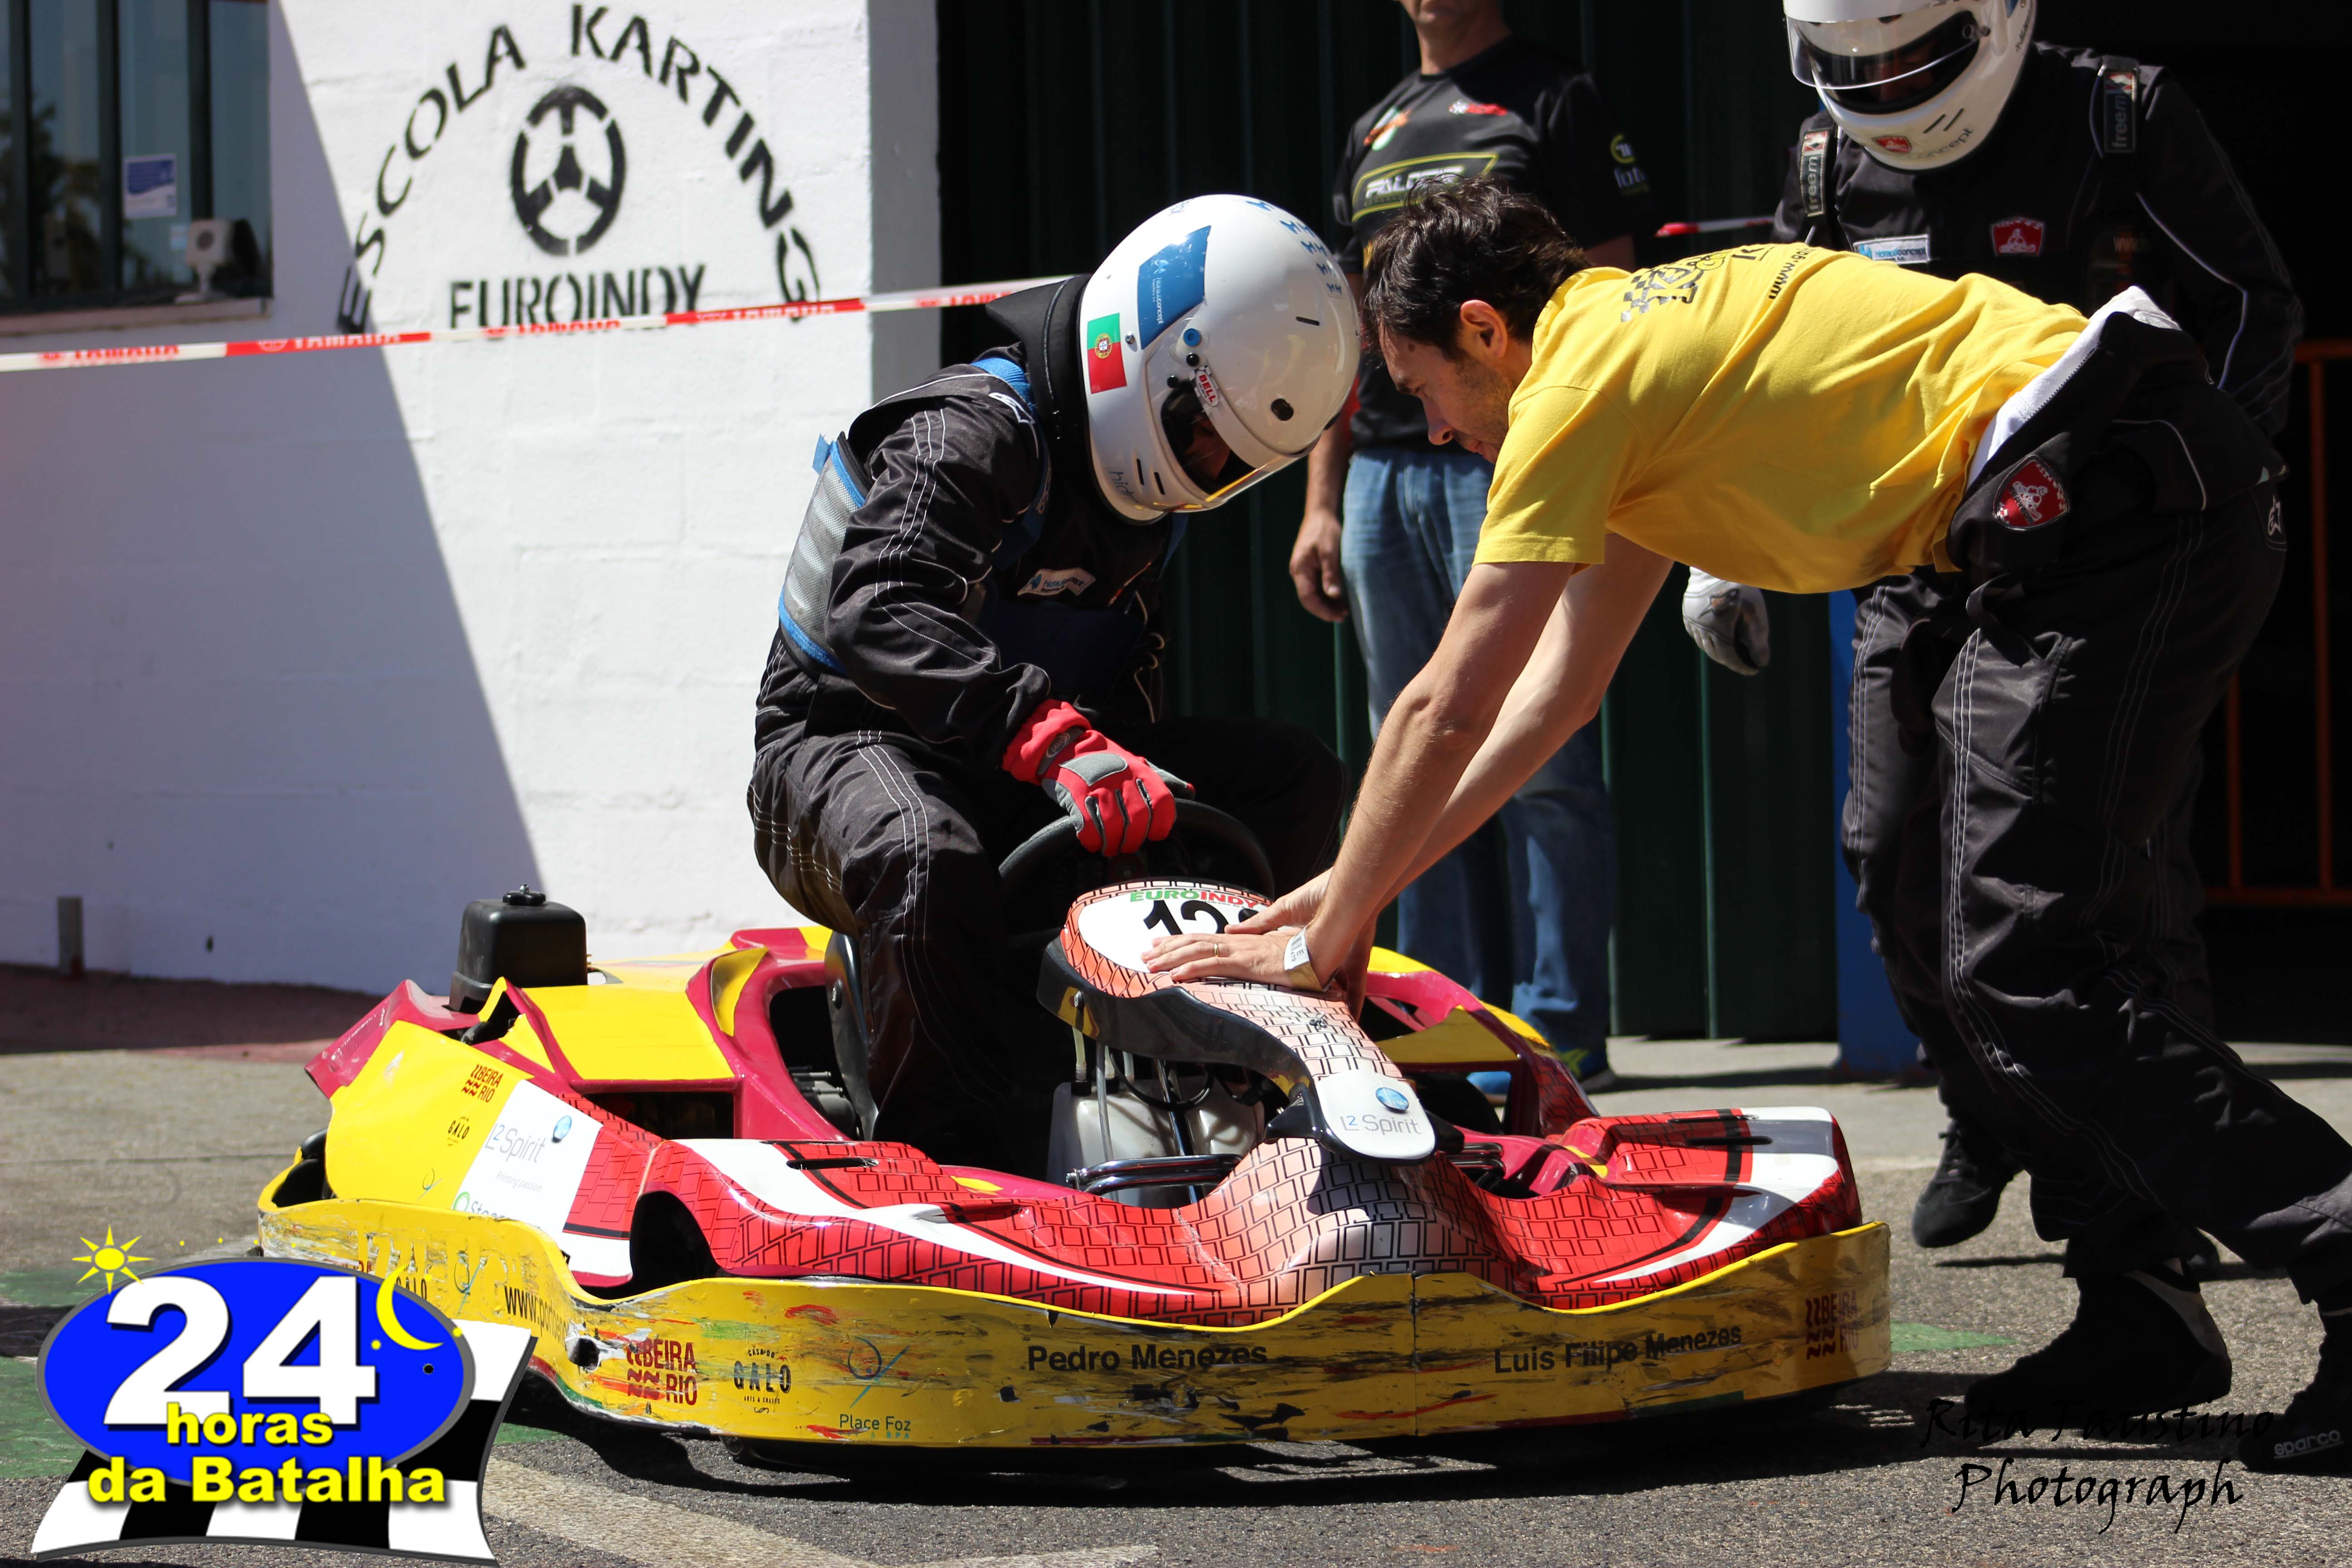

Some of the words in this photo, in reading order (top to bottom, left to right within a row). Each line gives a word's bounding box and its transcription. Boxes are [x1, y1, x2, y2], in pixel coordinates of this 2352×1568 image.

[336, 24, 526, 334] ESCOLA
[571, 4, 819, 323] KARTING
[1199, 374, 1216, 402] BELL
[1130, 890, 1259, 908] EUROINDY
[1143, 900, 1259, 936] 12
[478, 1085, 495, 1103] RIO
[1362, 1114, 1422, 1136] Spirit
[500, 1127, 547, 1163] Spirit
[495, 1171, 520, 1188] Printing
[767, 1350, 775, 1358] DO
[1028, 1345, 1120, 1371] Pedro
[1132, 1343, 1268, 1370] Menezes
[1494, 1345, 1555, 1374] Luis
[1565, 1338, 1638, 1371] Filipe
[1645, 1324, 1743, 1360] Menezes
[666, 1373, 698, 1406] RIO
[733, 1360, 792, 1394] GALO
[840, 1413, 880, 1430] Place
[886, 1416, 911, 1431] Foz
